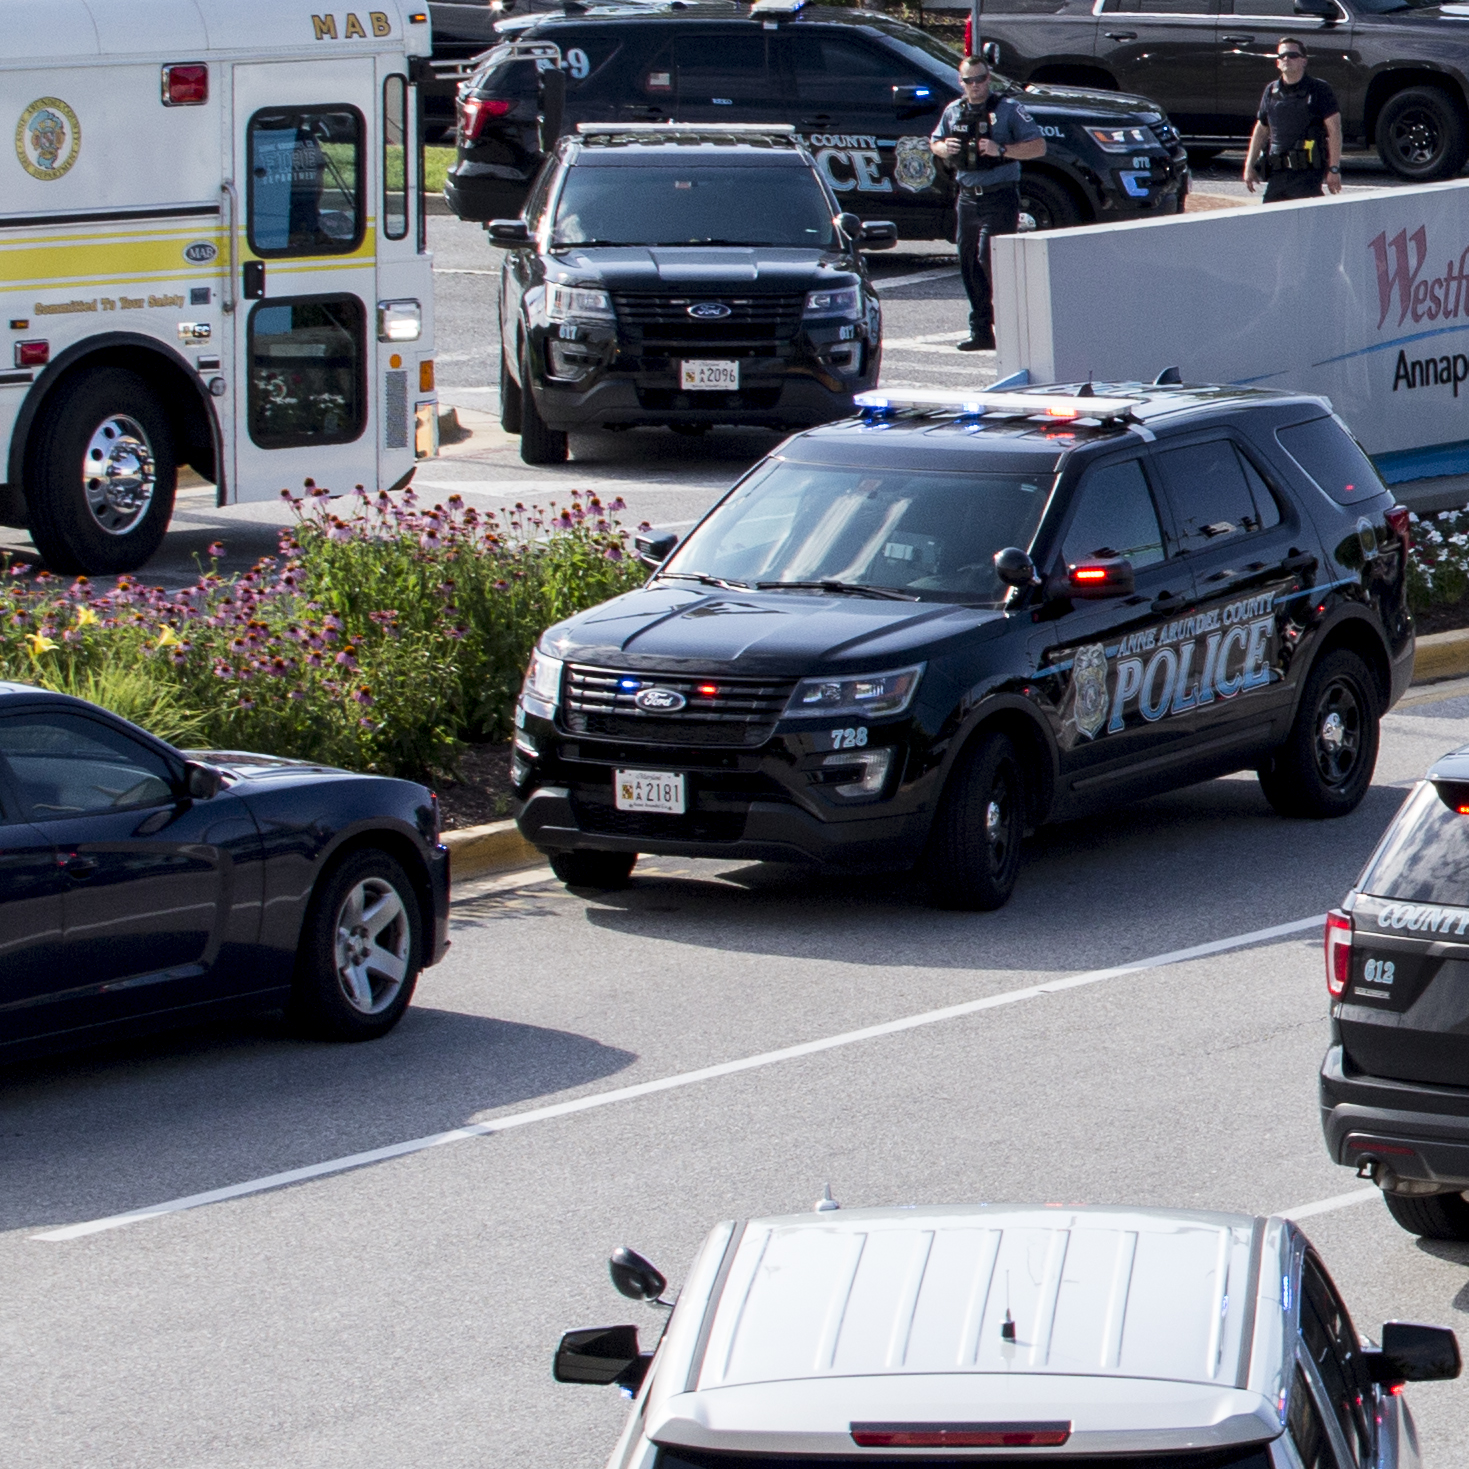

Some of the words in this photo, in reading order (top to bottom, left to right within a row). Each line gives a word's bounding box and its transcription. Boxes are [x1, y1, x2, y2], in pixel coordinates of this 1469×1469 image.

[311, 11, 391, 40] MAB
[809, 133, 877, 149] COUNTY
[188, 246, 214, 259] MAB
[34, 299, 98, 316] Committed
[101, 297, 116, 311] To
[119, 296, 146, 310] Your
[148, 293, 185, 309] Safety
[707, 367, 737, 383] 2096
[1116, 628, 1158, 658] ANNE
[1158, 609, 1222, 645] ARUNDEL
[1222, 591, 1276, 625] COUNTY
[1107, 613, 1275, 734] POLICE
[642, 692, 675, 707] Ford
[831, 727, 868, 749] 728
[646, 782, 679, 803] 2181
[1363, 958, 1396, 984] 612
